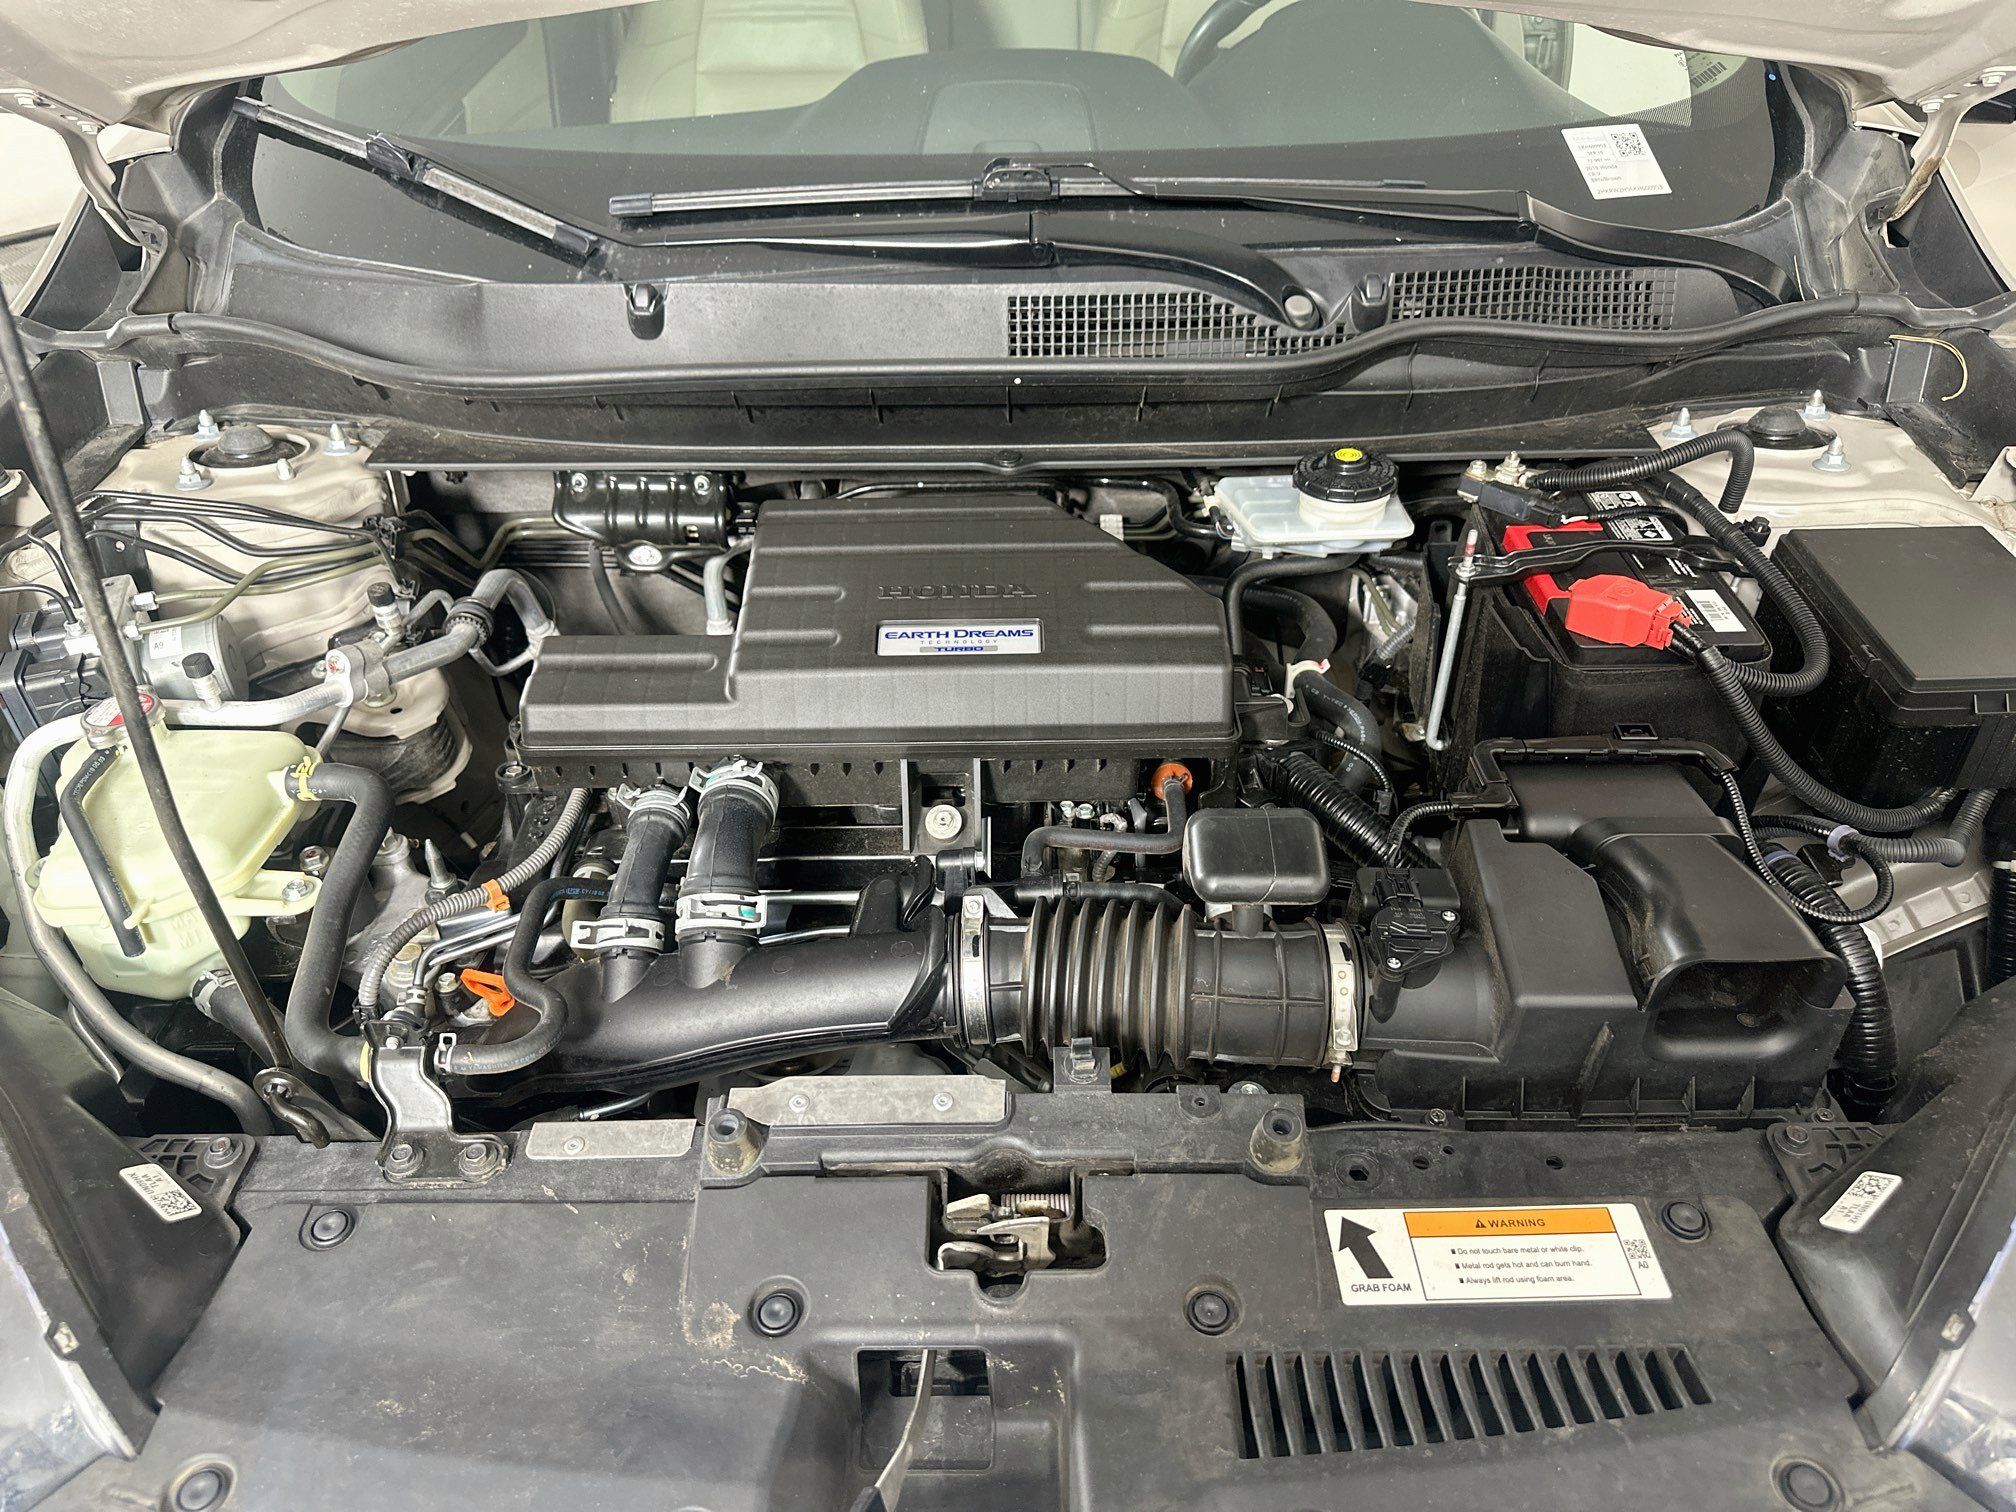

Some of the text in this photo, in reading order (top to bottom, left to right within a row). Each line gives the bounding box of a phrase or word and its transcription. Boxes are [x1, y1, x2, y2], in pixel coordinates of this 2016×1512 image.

[878, 584, 1037, 600] HONDA
[884, 630, 1034, 639] EARTH DREAMS
[1488, 1218, 1545, 1228] WARNING
[1466, 1277, 1491, 1285] Always
[1516, 1276, 1536, 1284] using
[1351, 1283, 1412, 1292] GRAB FOAM
